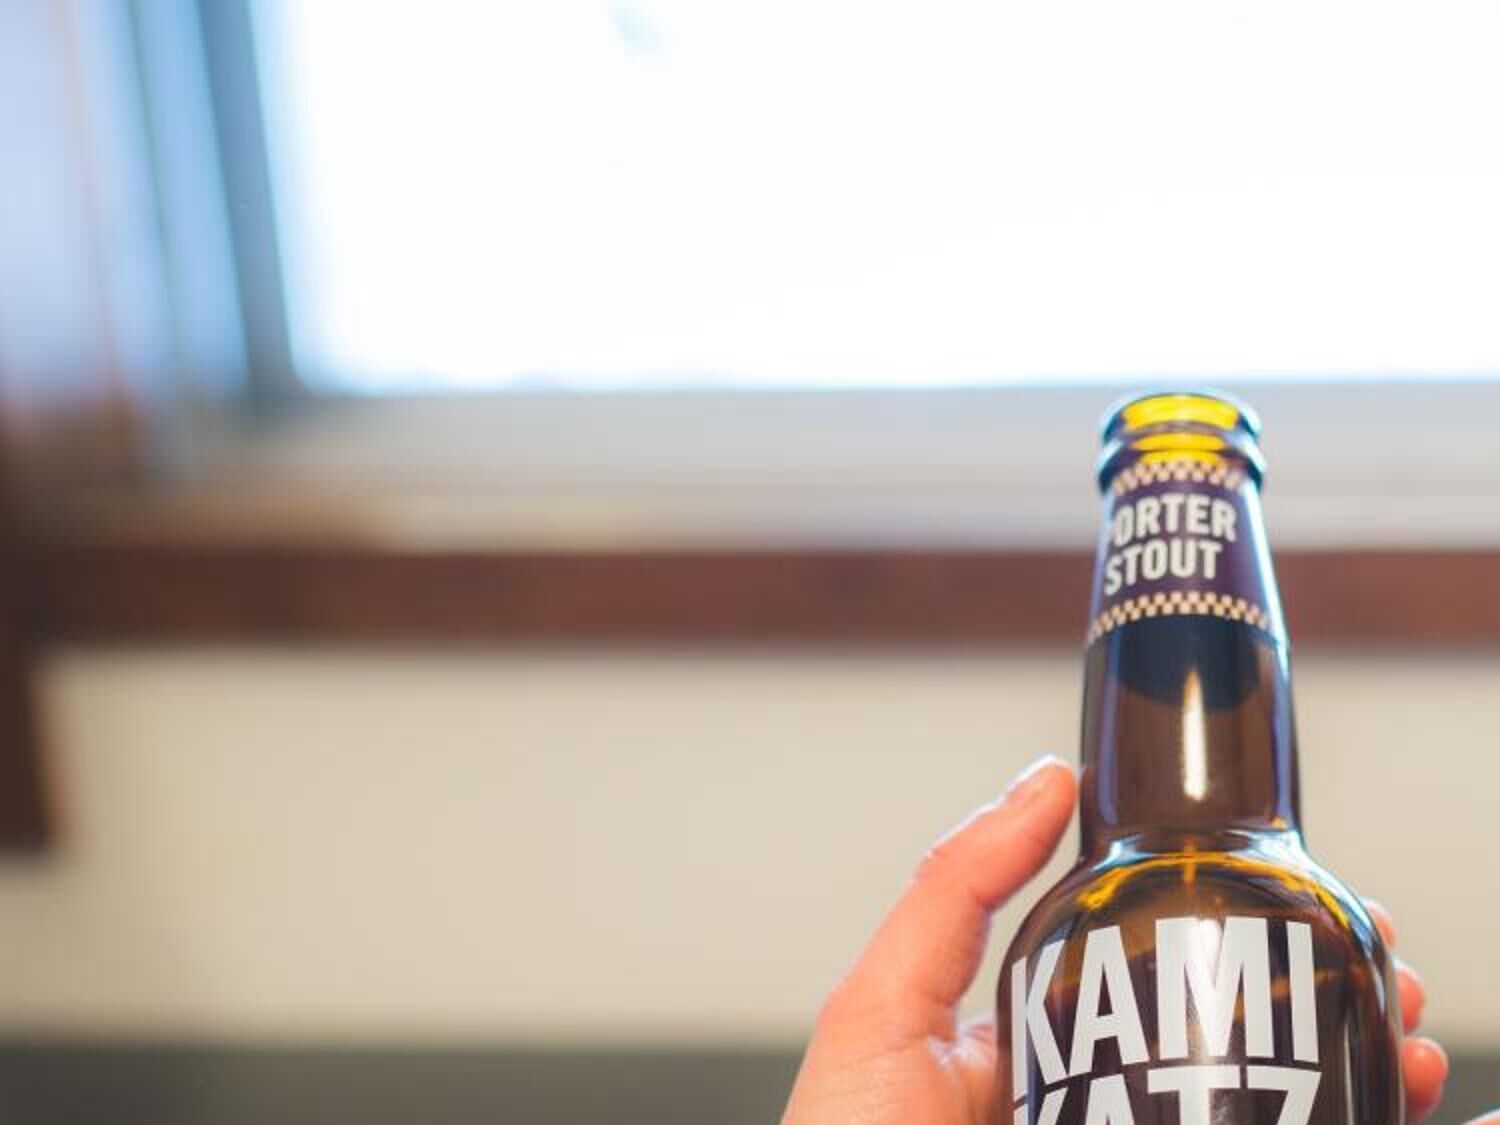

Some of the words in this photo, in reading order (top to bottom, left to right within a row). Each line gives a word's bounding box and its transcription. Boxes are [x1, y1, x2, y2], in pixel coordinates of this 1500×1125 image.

[1113, 493, 1238, 546] ORTER
[1104, 537, 1222, 596] STOUT
[1012, 916, 1319, 1100] KAMI
